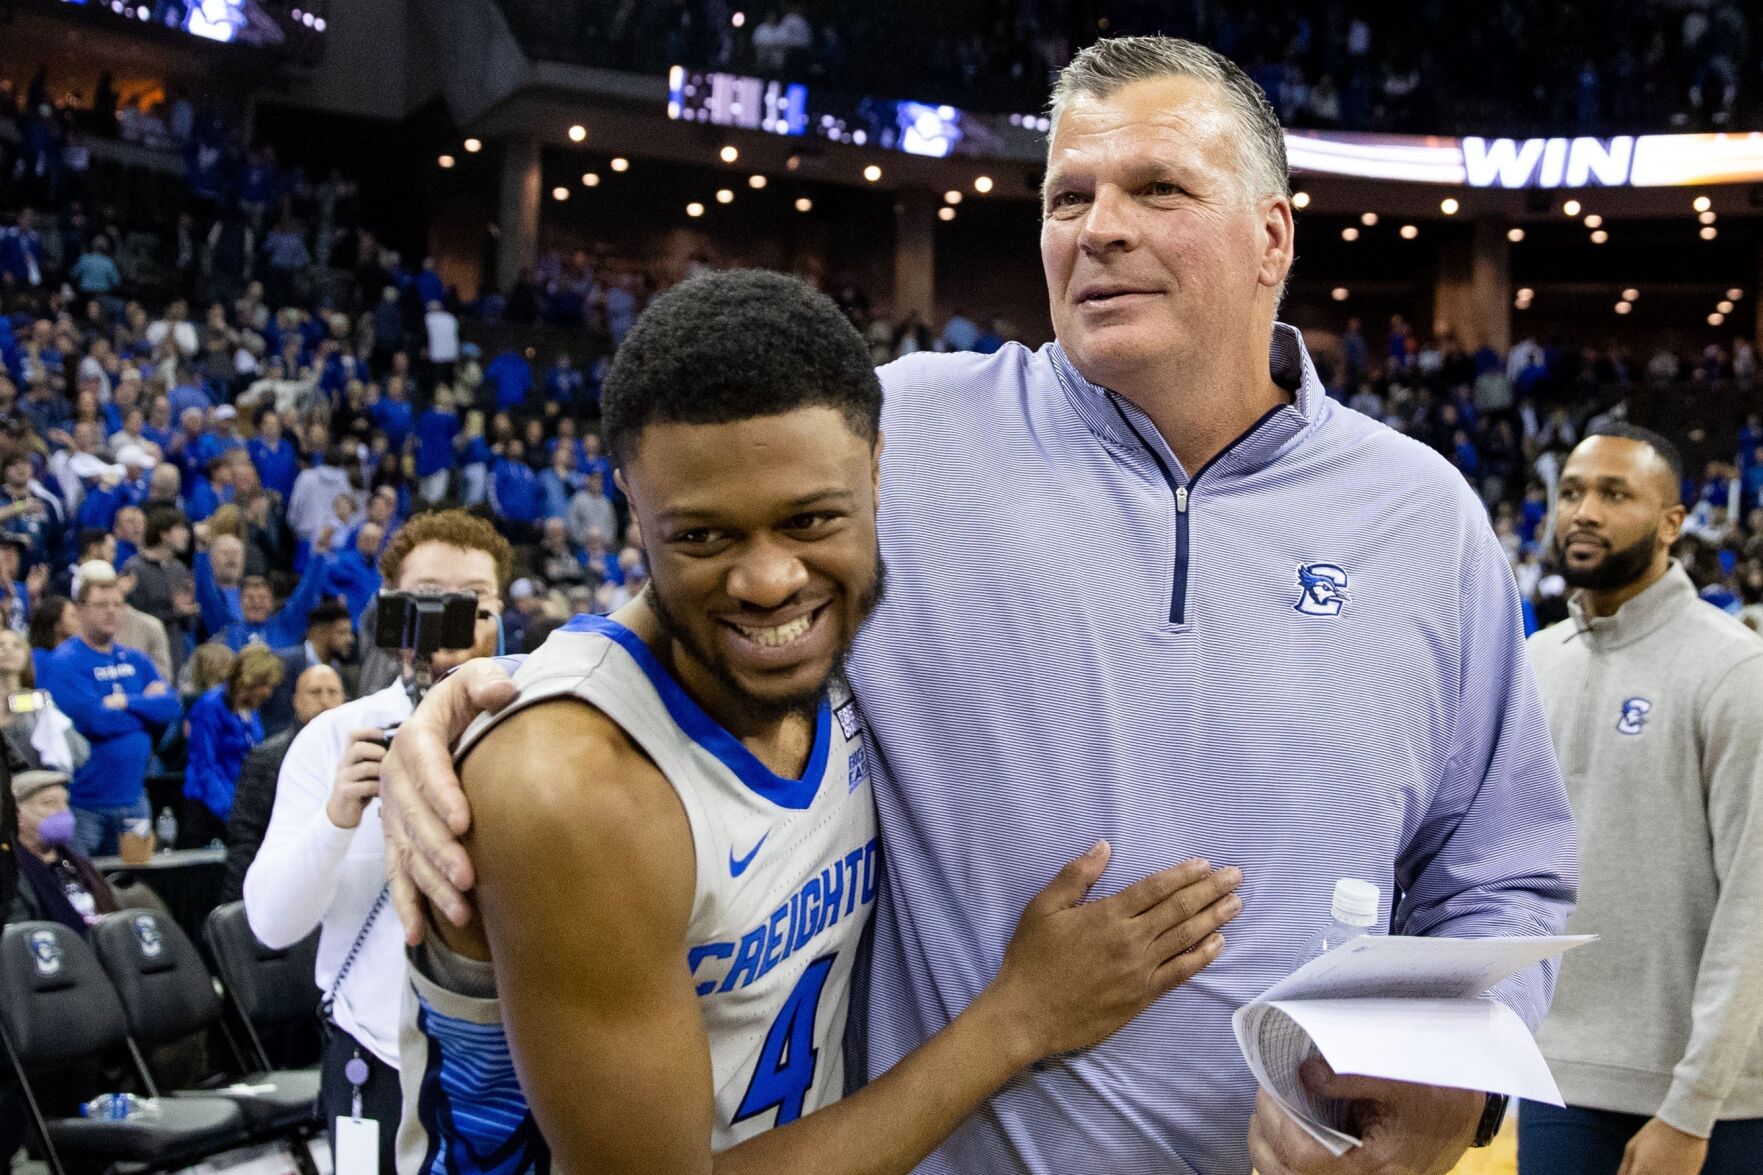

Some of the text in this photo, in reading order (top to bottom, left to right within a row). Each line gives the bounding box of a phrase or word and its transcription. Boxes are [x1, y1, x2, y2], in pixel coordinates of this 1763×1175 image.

[1463, 136, 1634, 188] WIN
[848, 747, 865, 768] BIG
[729, 951, 839, 1129] 4
